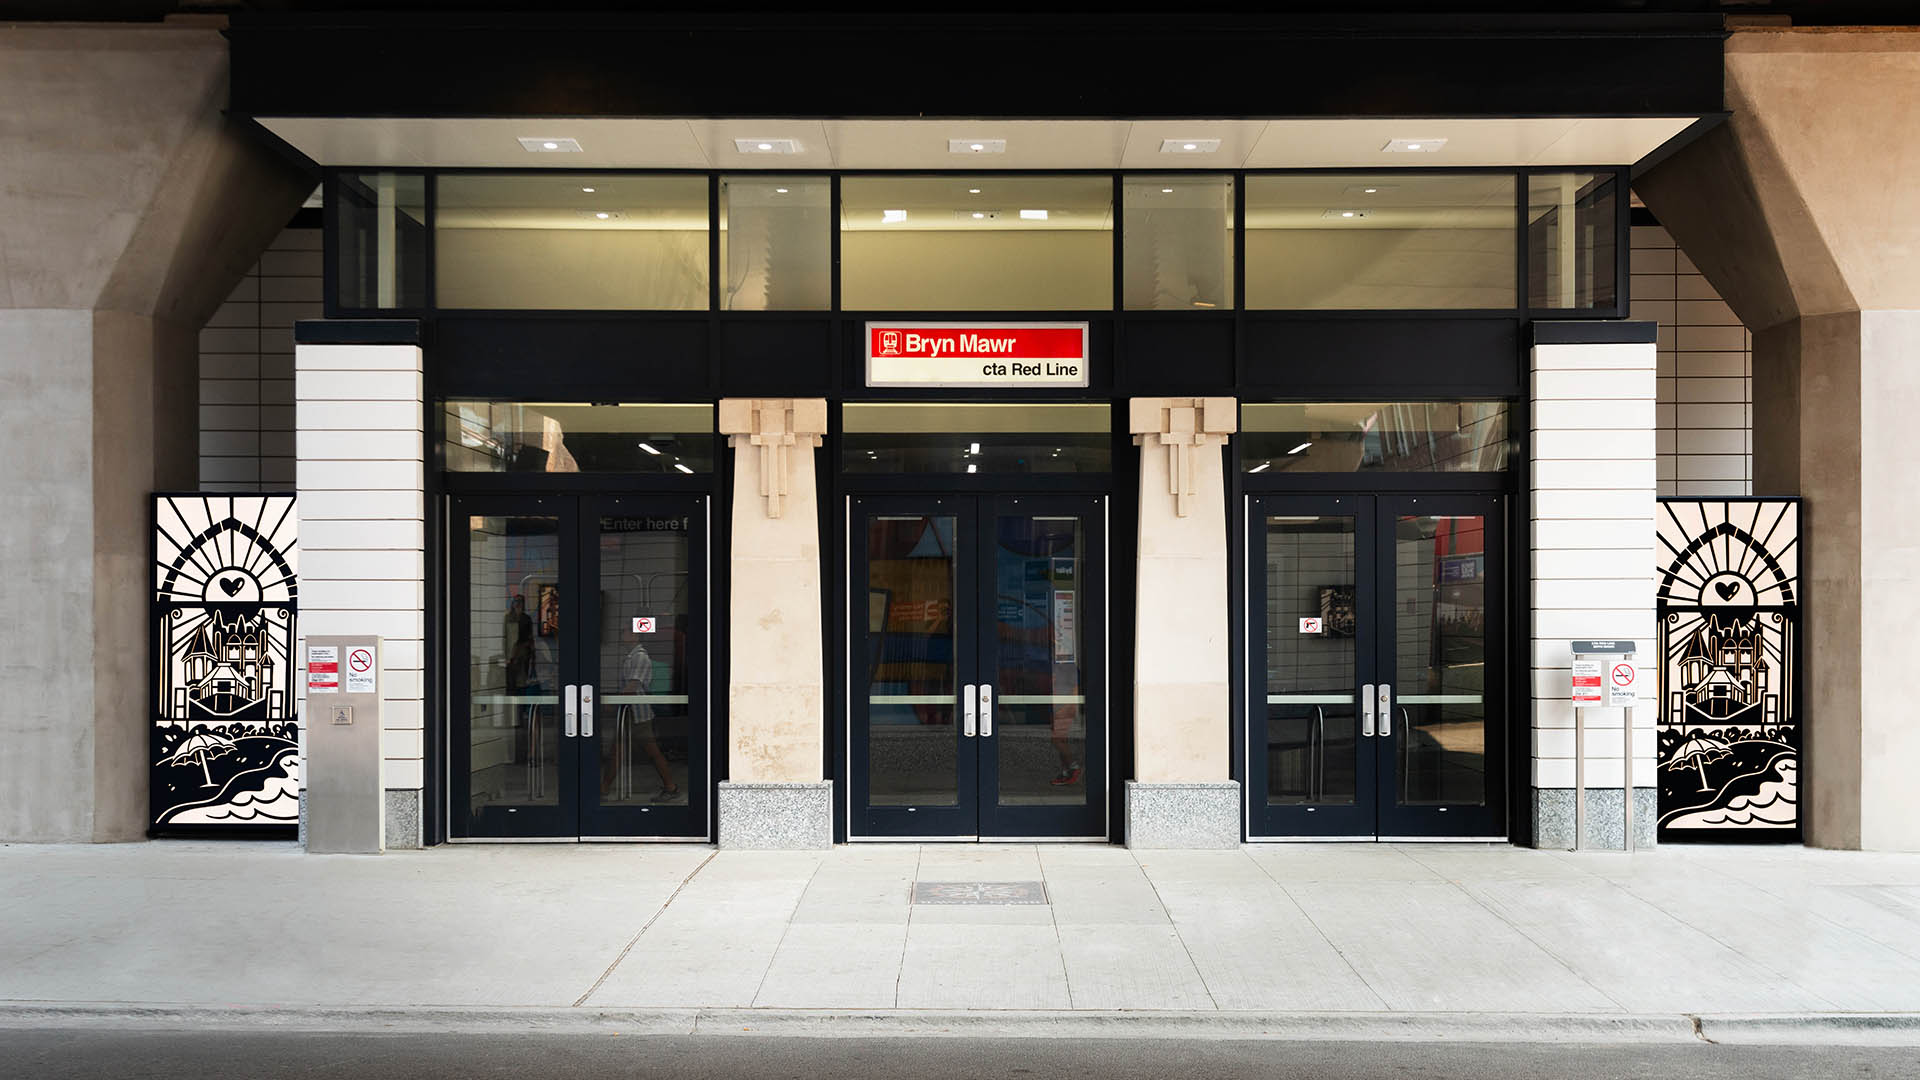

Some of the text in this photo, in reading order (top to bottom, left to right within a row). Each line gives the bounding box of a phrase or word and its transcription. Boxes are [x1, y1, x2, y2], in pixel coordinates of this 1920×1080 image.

[906, 334, 1016, 357] Bryn Mawr
[982, 363, 1078, 376] cta Red Line
[603, 518, 642, 530] Enter
[647, 517, 679, 530] here
